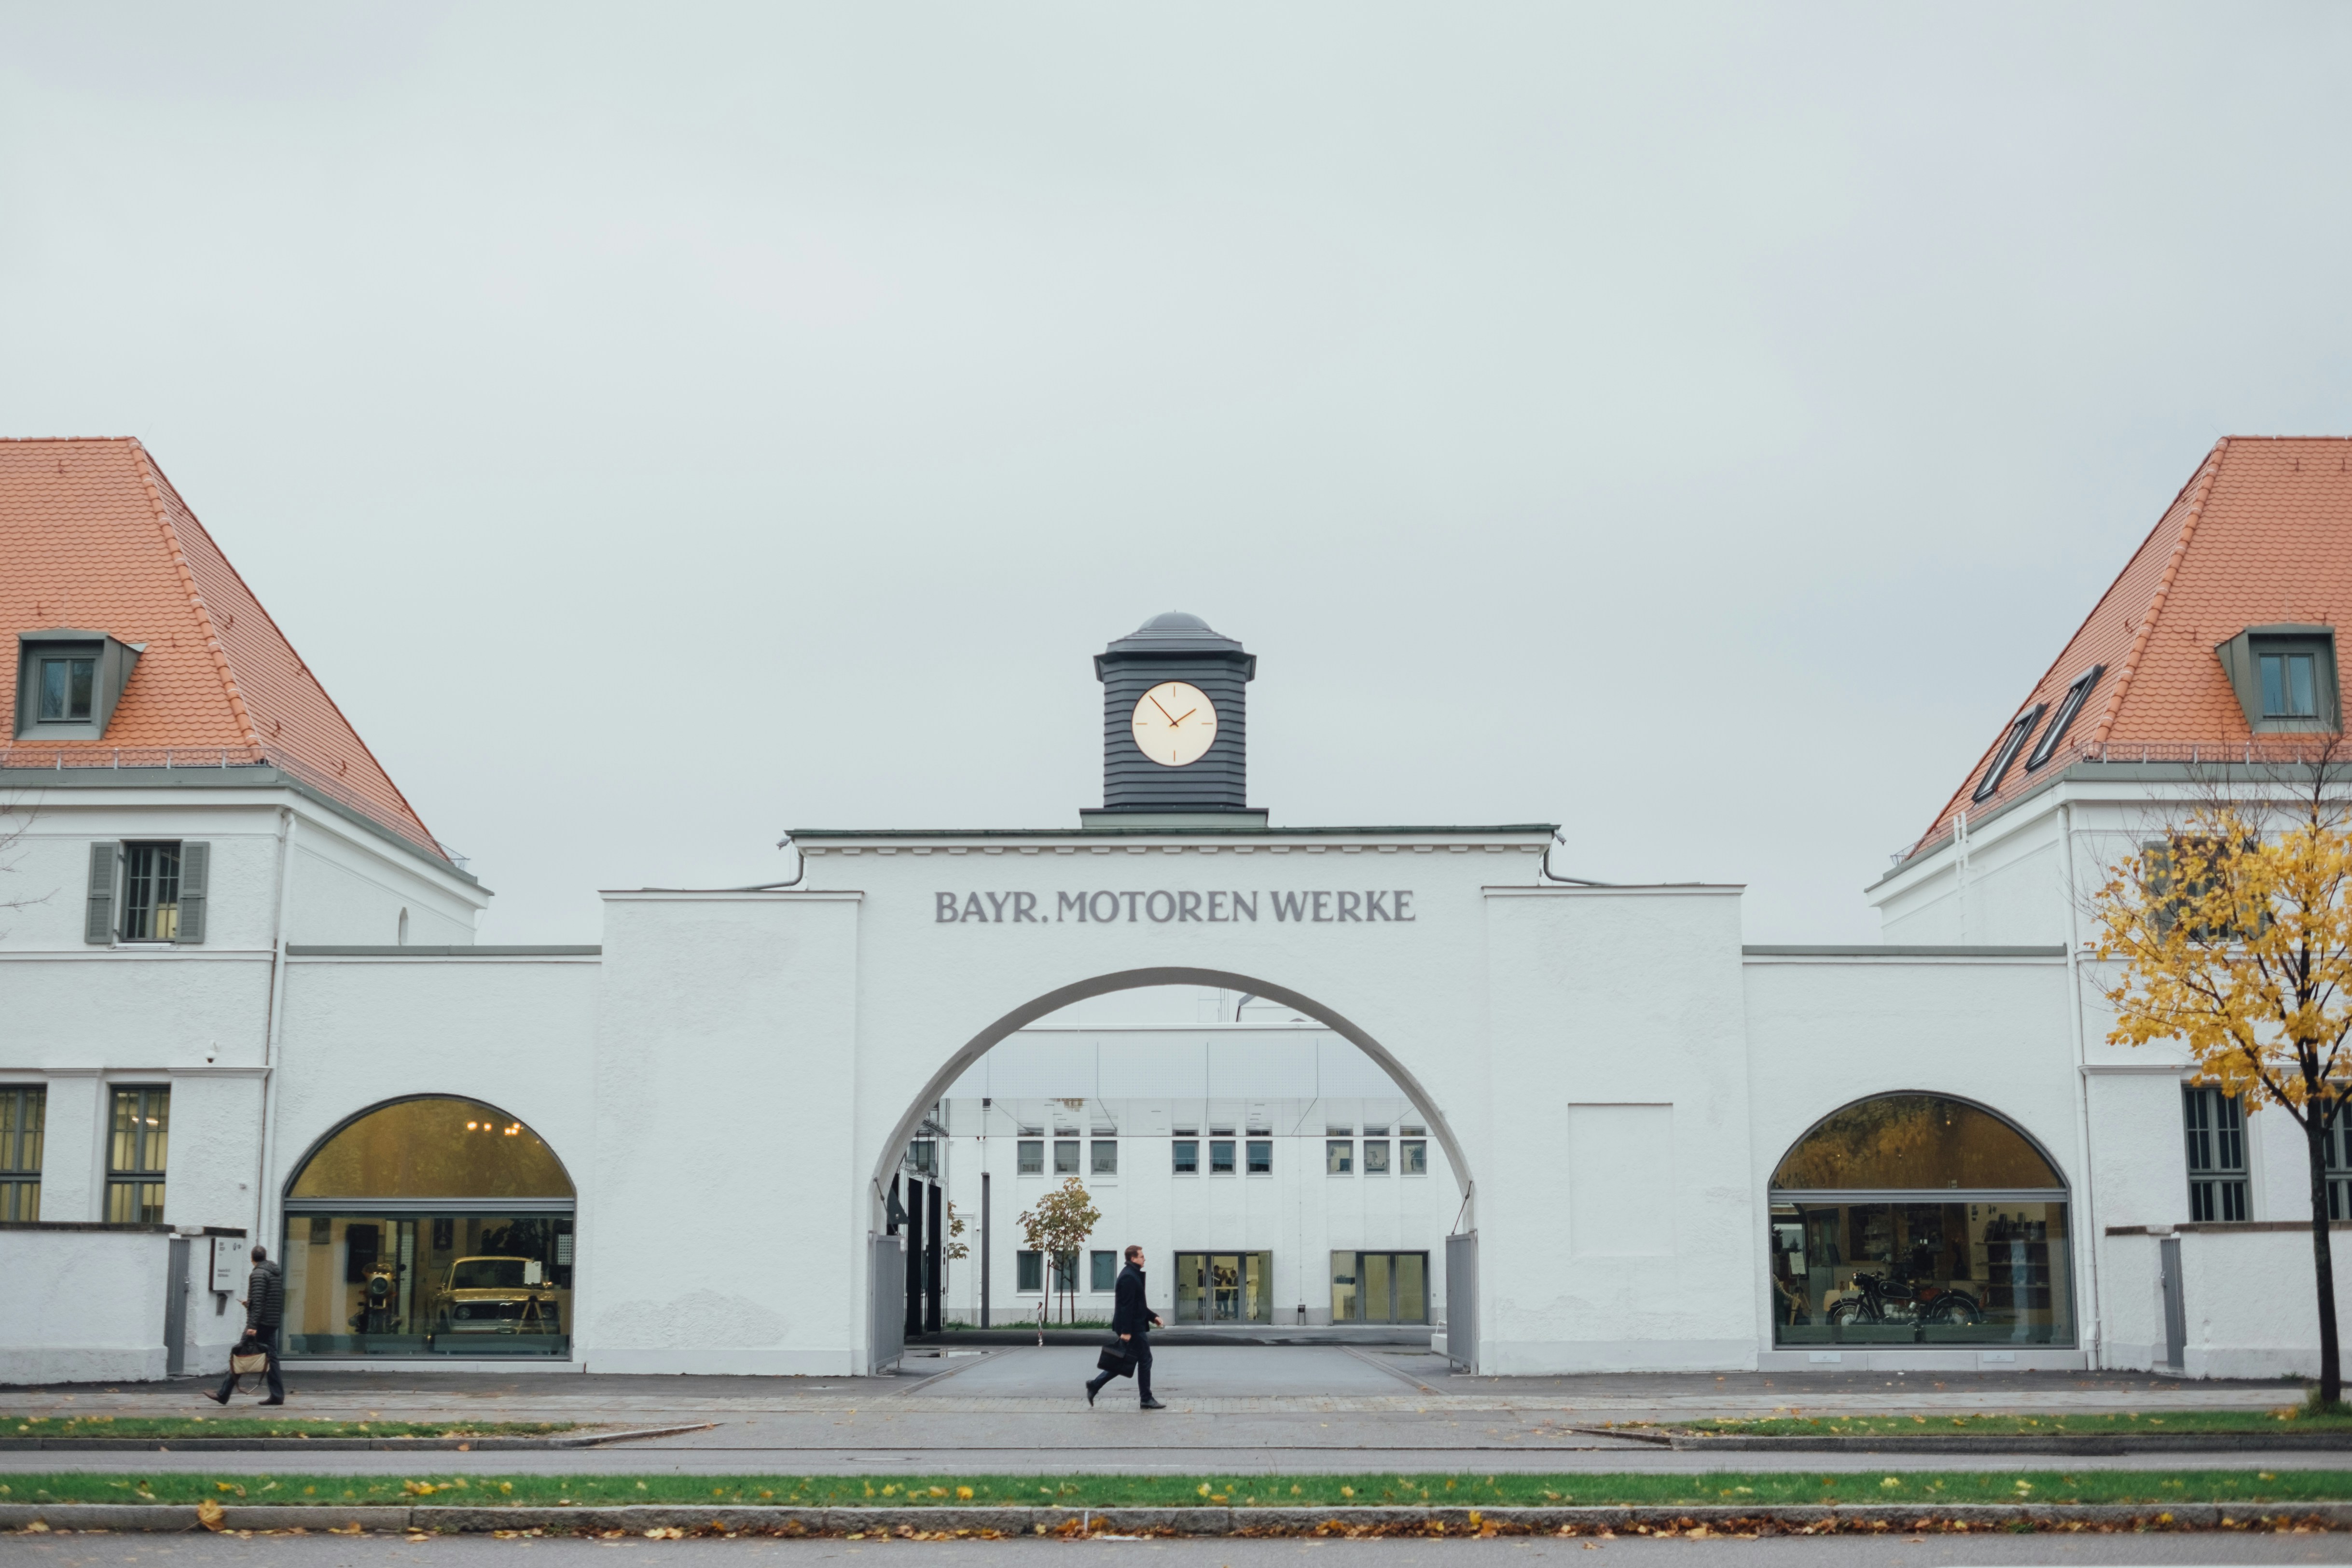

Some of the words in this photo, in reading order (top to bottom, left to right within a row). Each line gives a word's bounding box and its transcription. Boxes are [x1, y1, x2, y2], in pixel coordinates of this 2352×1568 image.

[935, 891, 1048, 923] BAYR.
[1056, 890, 1258, 923] MOTOREN
[1270, 890, 1416, 923] WERKE
